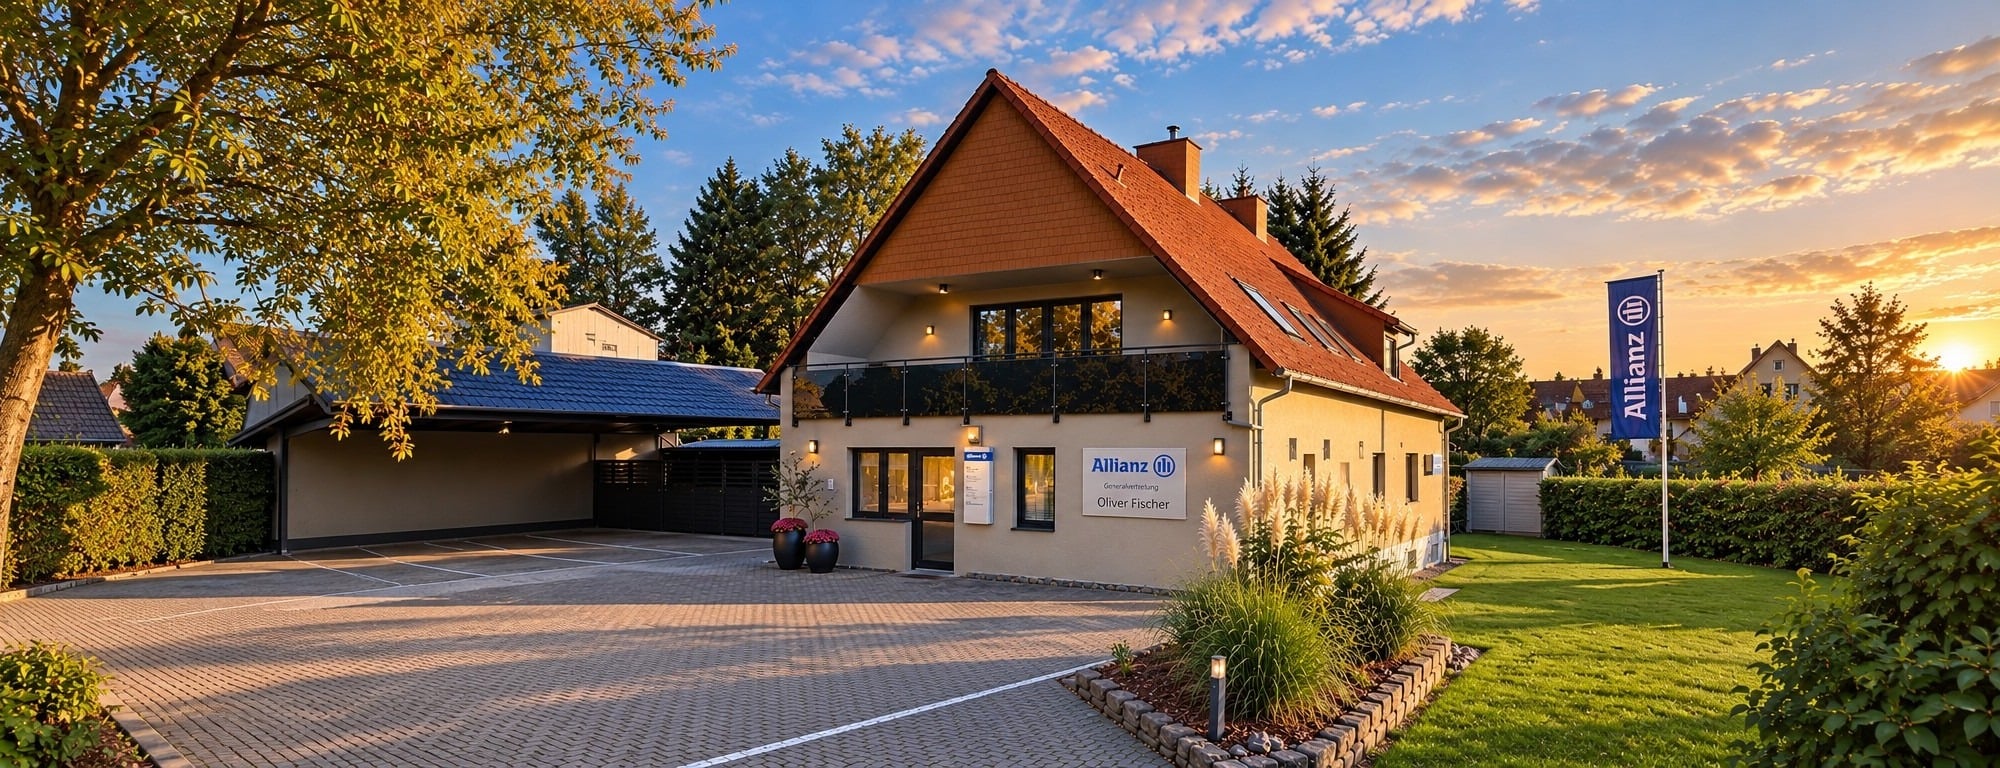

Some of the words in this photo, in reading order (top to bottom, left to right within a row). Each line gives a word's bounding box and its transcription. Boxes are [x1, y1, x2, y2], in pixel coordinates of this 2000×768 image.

[1624, 332, 1647, 421] Allianz
[1091, 457, 1148, 473] Allianz
[1097, 497, 1129, 508] Oliver
[1131, 498, 1170, 510] Fischer
